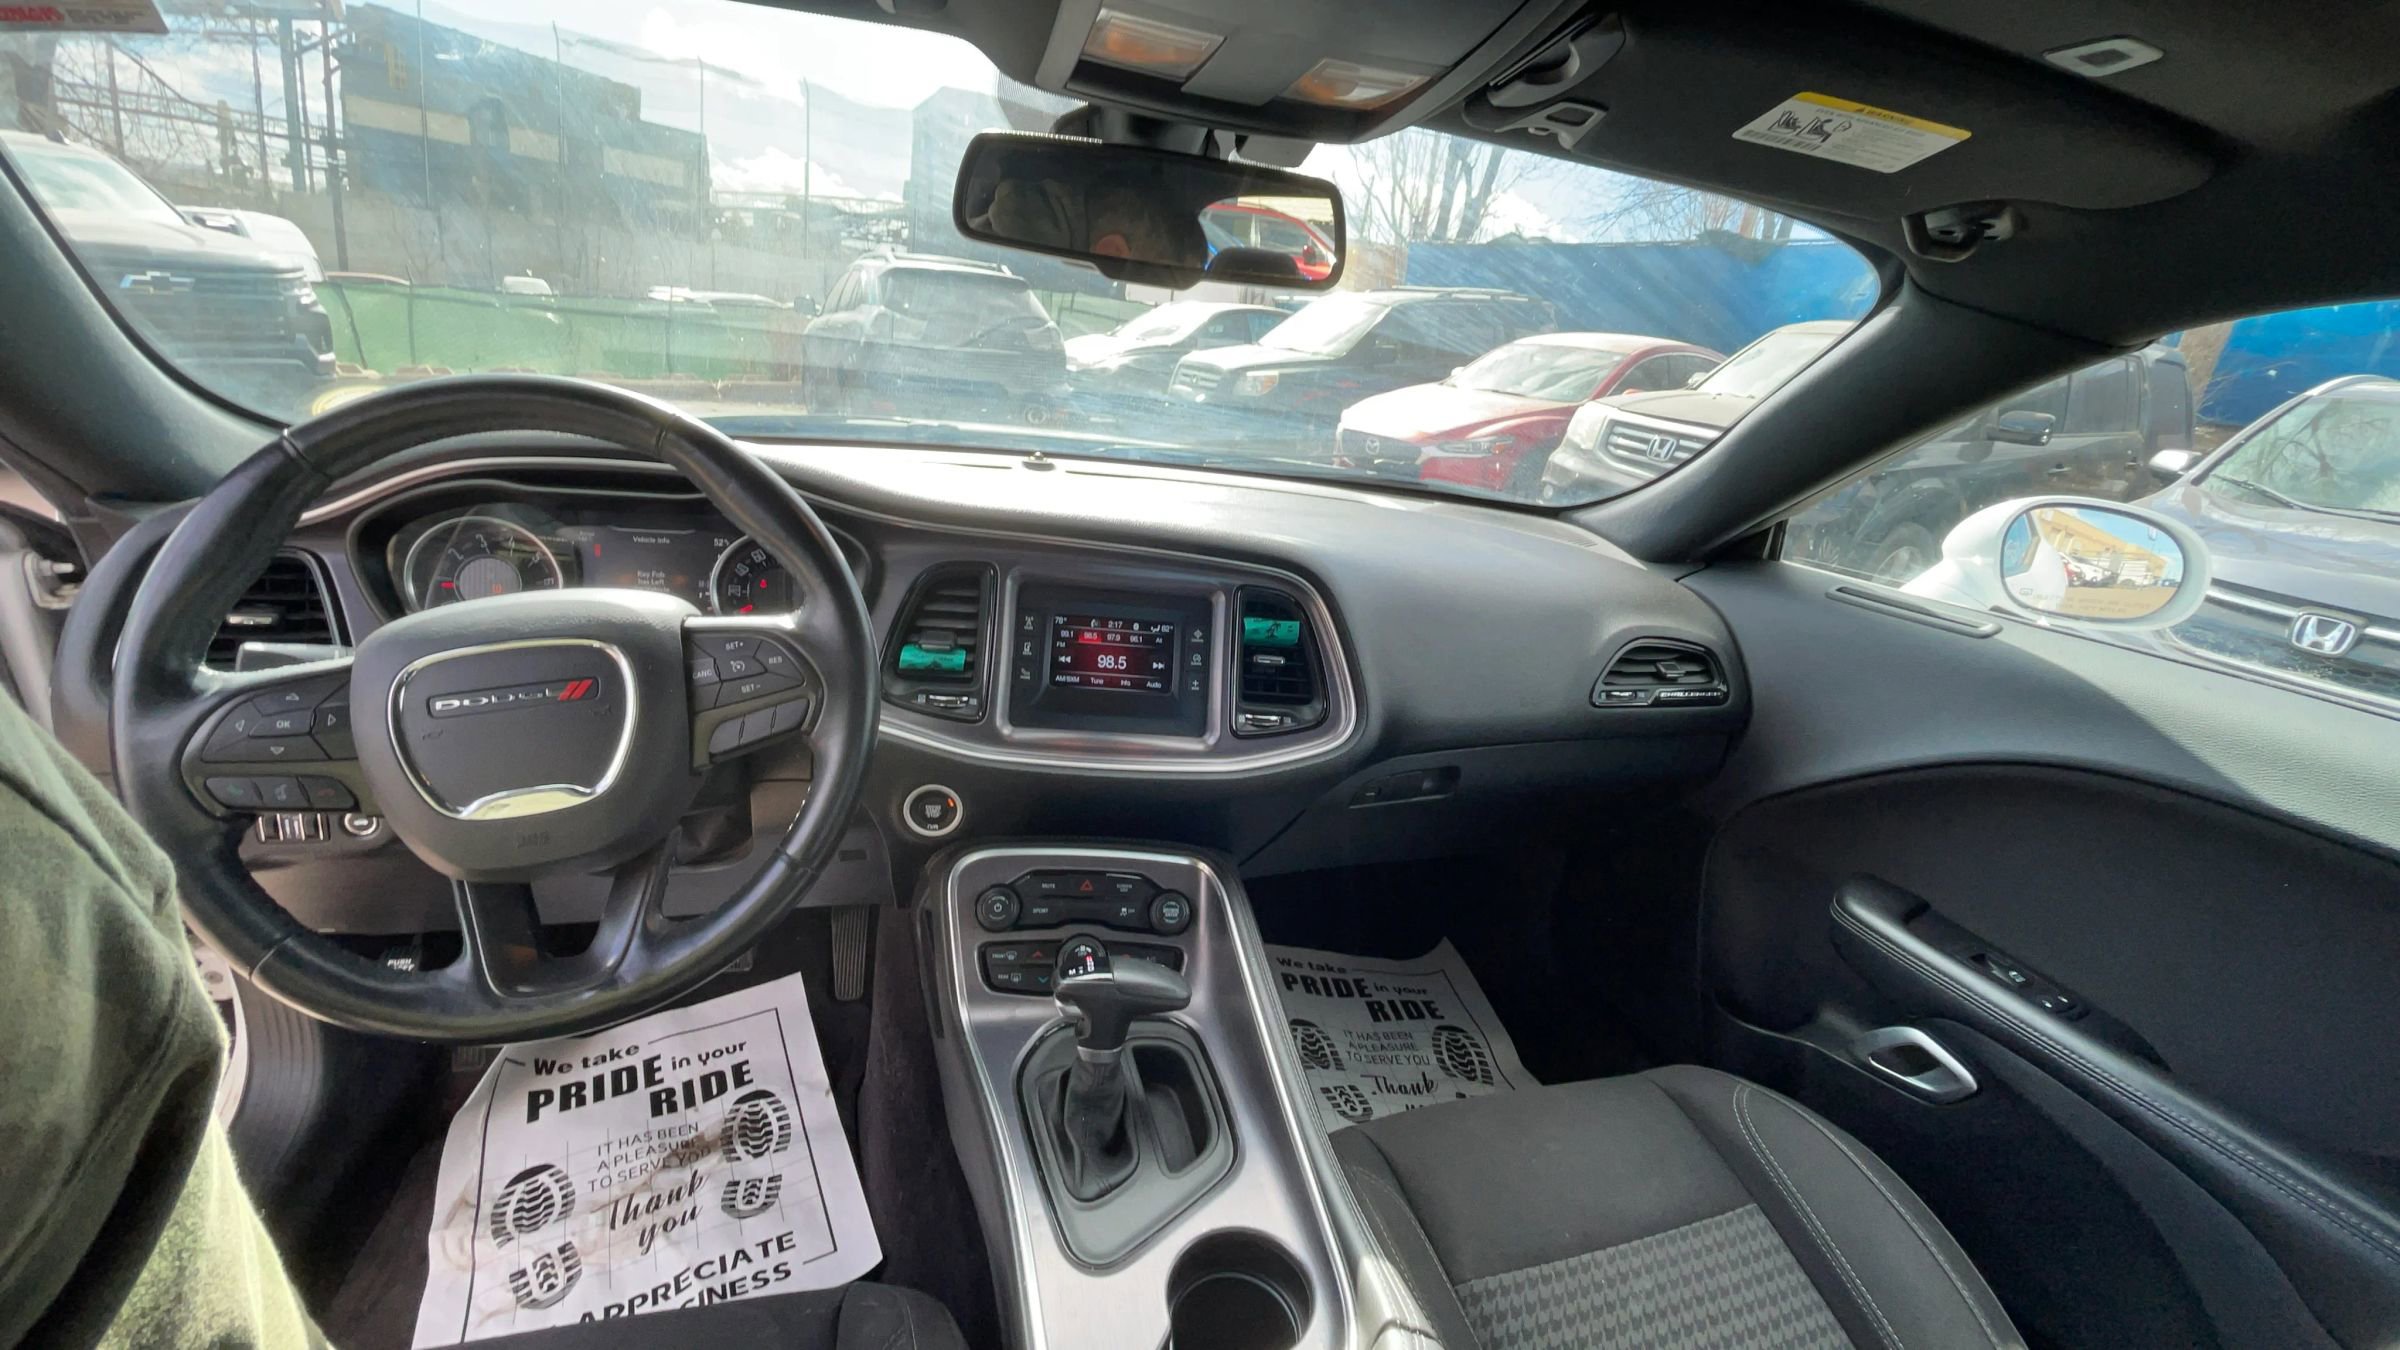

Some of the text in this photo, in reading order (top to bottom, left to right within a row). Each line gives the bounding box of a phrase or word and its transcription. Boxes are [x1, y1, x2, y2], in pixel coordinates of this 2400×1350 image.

[1097, 654, 1127, 670] 98.5
[1146, 681, 1162, 689] Auto
[276, 719, 291, 729] OK
[1275, 956, 1347, 974] We take
[1280, 971, 1428, 998] PRIDE in your
[1364, 999, 1445, 1023] RIDE
[533, 1043, 640, 1076] We take
[1363, 1054, 1404, 1065] SERVE
[1404, 1054, 1431, 1066] YOU
[526, 1040, 748, 1124] PRIDE in your
[649, 1060, 754, 1118] RIDE
[1360, 1071, 1439, 1096] Thank
[596, 1137, 704, 1173] A PLEASURE
[597, 1122, 699, 1157] IT HAS BEEN
[588, 1175, 613, 1193] TO
[617, 1156, 675, 1182] SERVE
[599, 1169, 709, 1230] Thank
[638, 1204, 703, 1256] you
[579, 1230, 797, 1323] APPRECIATE
